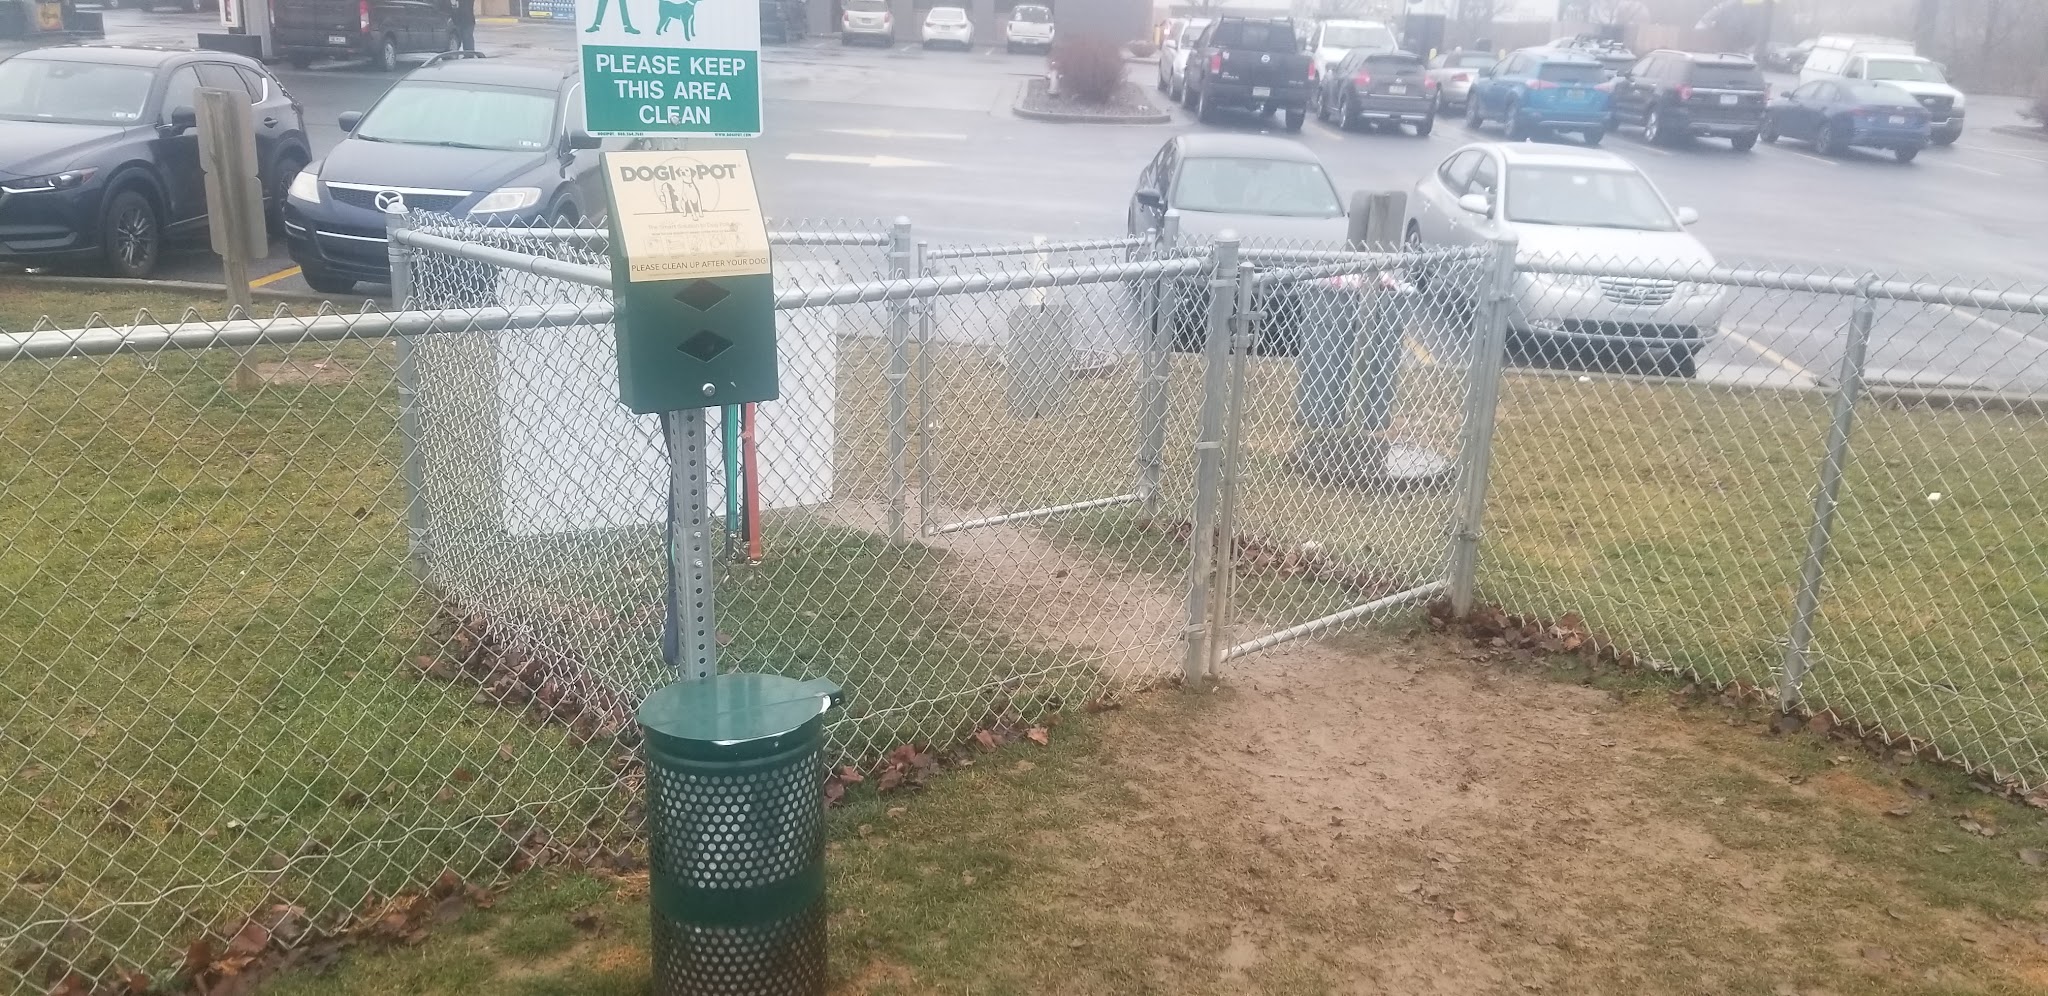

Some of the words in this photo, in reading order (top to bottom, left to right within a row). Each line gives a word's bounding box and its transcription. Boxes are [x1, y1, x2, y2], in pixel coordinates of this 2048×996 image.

[596, 54, 681, 75] PLEASE
[690, 57, 746, 76] KEEP
[614, 79, 665, 100] THIS
[673, 81, 732, 101] AREA
[639, 105, 711, 125] CLEAN
[631, 263, 660, 272] PLEASE
[661, 262, 688, 270] CLEAN
[689, 261, 700, 269] UP
[701, 260, 725, 268] AFTER
[727, 258, 748, 267] YOUR
